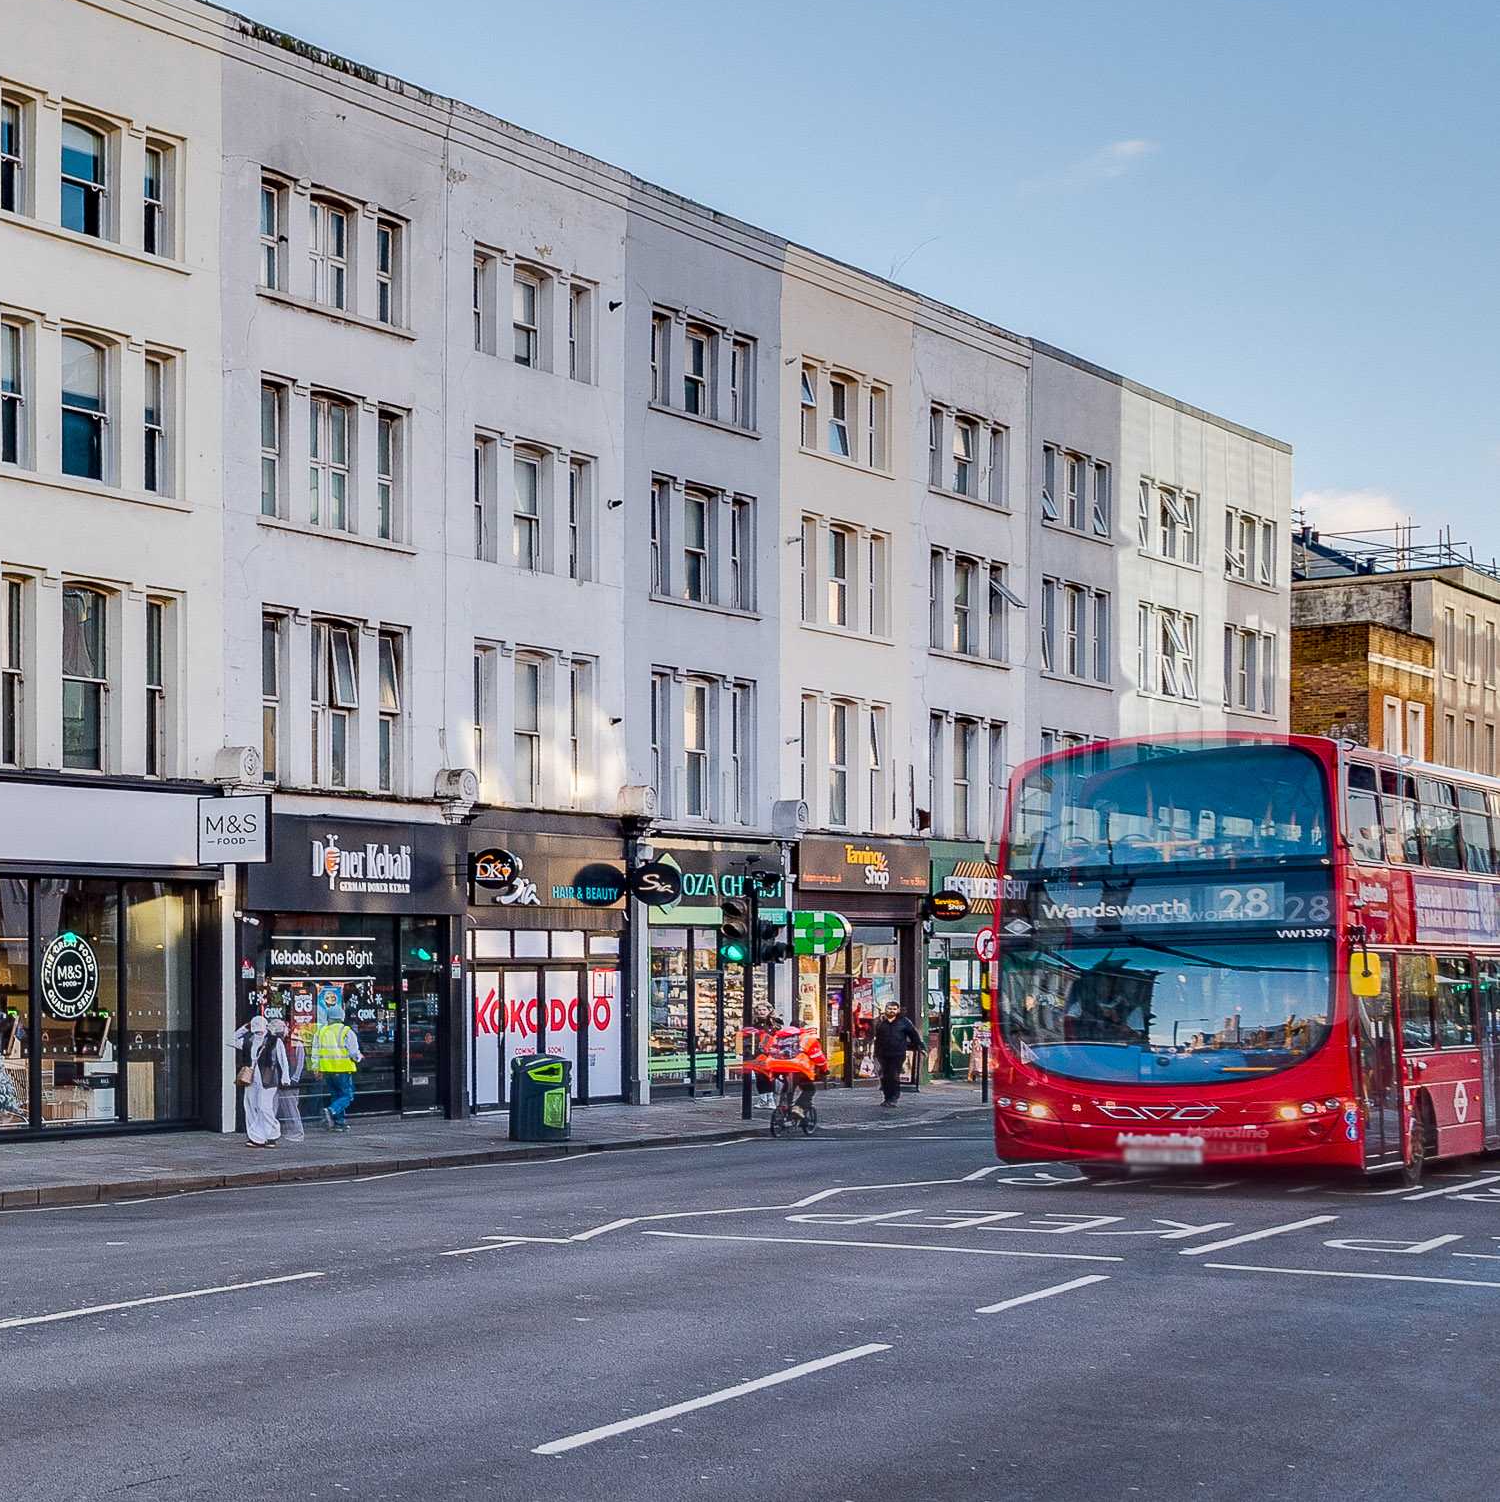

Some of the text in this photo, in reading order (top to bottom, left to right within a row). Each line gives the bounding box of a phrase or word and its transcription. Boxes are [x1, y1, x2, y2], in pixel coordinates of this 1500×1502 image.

[205, 814, 257, 835] M&S
[217, 837, 246, 845] FOOD
[864, 865, 890, 890] Shop
[552, 886, 619, 901] HAIR & BEAUTY
[1042, 888, 1269, 919] Wandsworth 28
[1277, 928, 1330, 939] VW1397
[78, 943, 95, 972] FOOD
[270, 949, 374, 969] Kebabs. Done Right
[56, 964, 83, 980] M&S
[47, 989, 76, 1014] QUALITY
[76, 989, 93, 1010] SEAL
[475, 987, 612, 1039] KOKODOO
